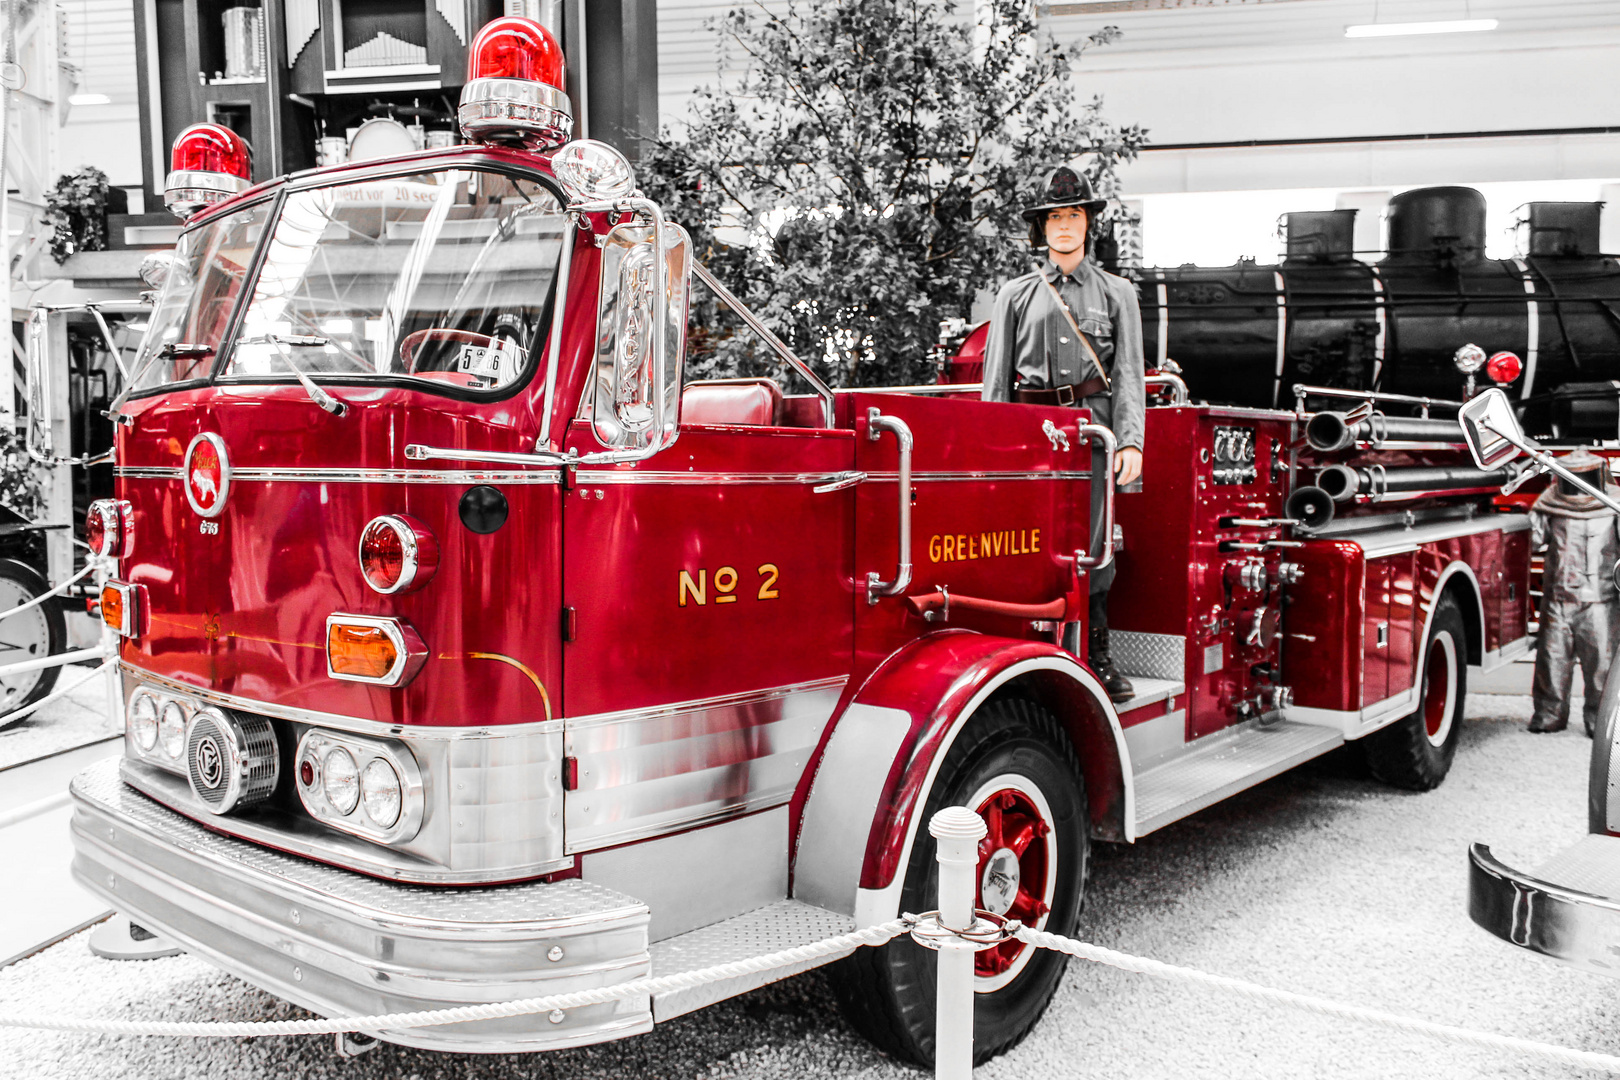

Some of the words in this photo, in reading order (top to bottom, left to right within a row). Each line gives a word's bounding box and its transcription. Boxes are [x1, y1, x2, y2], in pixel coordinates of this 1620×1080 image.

[393, 185, 410, 202] 20
[462, 348, 473, 370] 5
[928, 528, 1042, 564] GREENVILLE
[756, 563, 781, 601] 2
